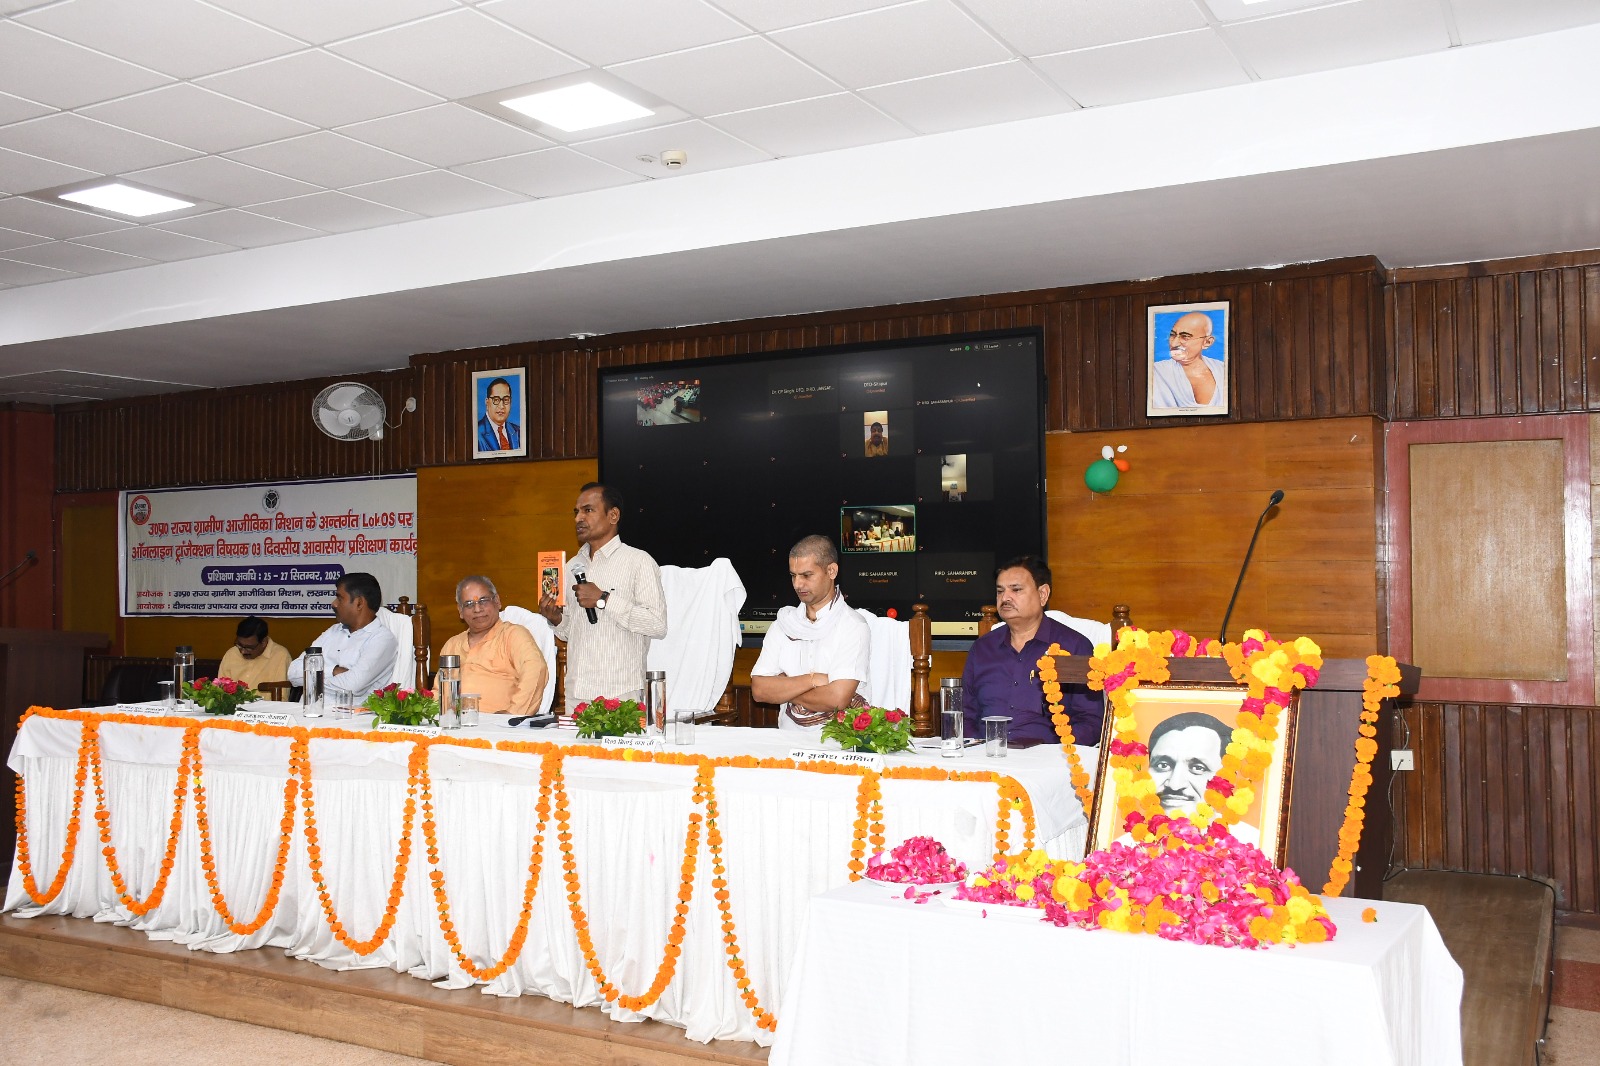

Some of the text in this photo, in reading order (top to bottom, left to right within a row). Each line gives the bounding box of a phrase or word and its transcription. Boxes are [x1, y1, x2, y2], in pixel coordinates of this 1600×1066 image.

[171, 522, 192, 536] राज्य
[194, 515, 224, 538] ग्रामीण
[226, 513, 272, 535] आजीविका
[275, 512, 303, 531] मिशन
[306, 511, 316, 530] के
[319, 508, 360, 530] अन्तर्गत
[362, 512, 395, 528] LokOS
[398, 512, 414, 528] पर
[131, 542, 173, 562] ऑनलाइन
[175, 540, 214, 565] ट्रांजैक्शन
[216, 538, 249, 558] विषयक
[252, 544, 261, 557] 03
[264, 536, 300, 556] दिवसीय
[302, 535, 346, 556] आवासीय
[348, 534, 388, 558] प्रशिक्षण
[207, 570, 234, 583] प्रशिक्षण
[236, 568, 257, 582] अवधि
[264, 572, 271, 581] 25
[280, 572, 288, 580] 27
[290, 568, 322, 581] सितम्बर,
[325, 571, 340, 580] 2025
[136, 590, 163, 598] प्रायोजक
[211, 588, 236, 598] ग्रामीण
[238, 588, 276, 597] आजीविका
[278, 588, 304, 598] मिशन,
[173, 601, 205, 610] दीनदयाल
[282, 601, 308, 610] विकास
